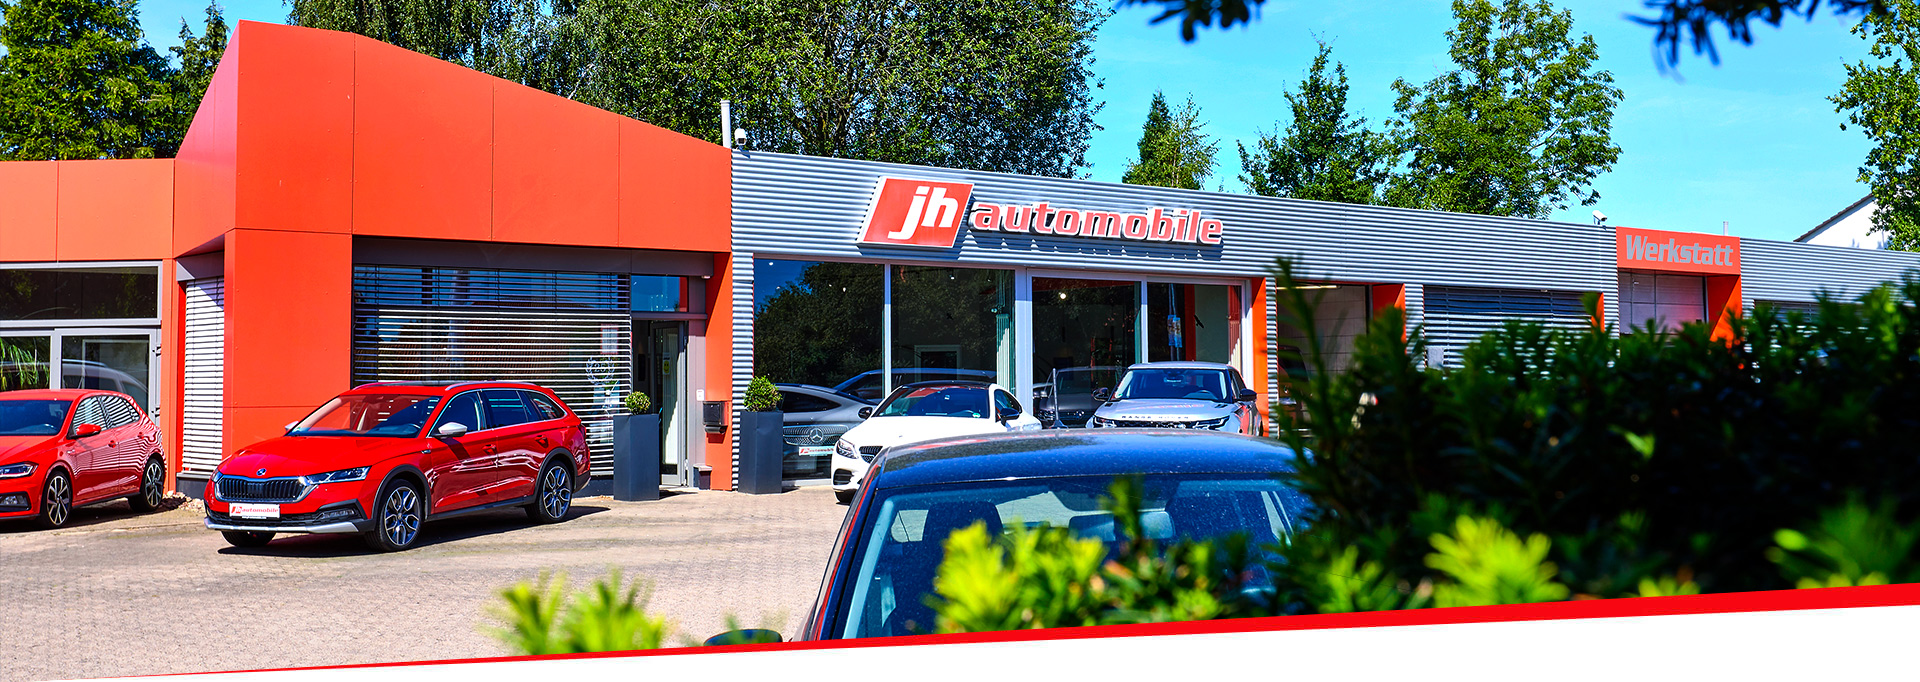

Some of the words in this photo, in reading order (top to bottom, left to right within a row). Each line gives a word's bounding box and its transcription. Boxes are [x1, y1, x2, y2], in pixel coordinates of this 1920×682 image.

[887, 185, 960, 240] jh
[969, 201, 1224, 244] automobile
[1625, 234, 1734, 266] Werkstatt
